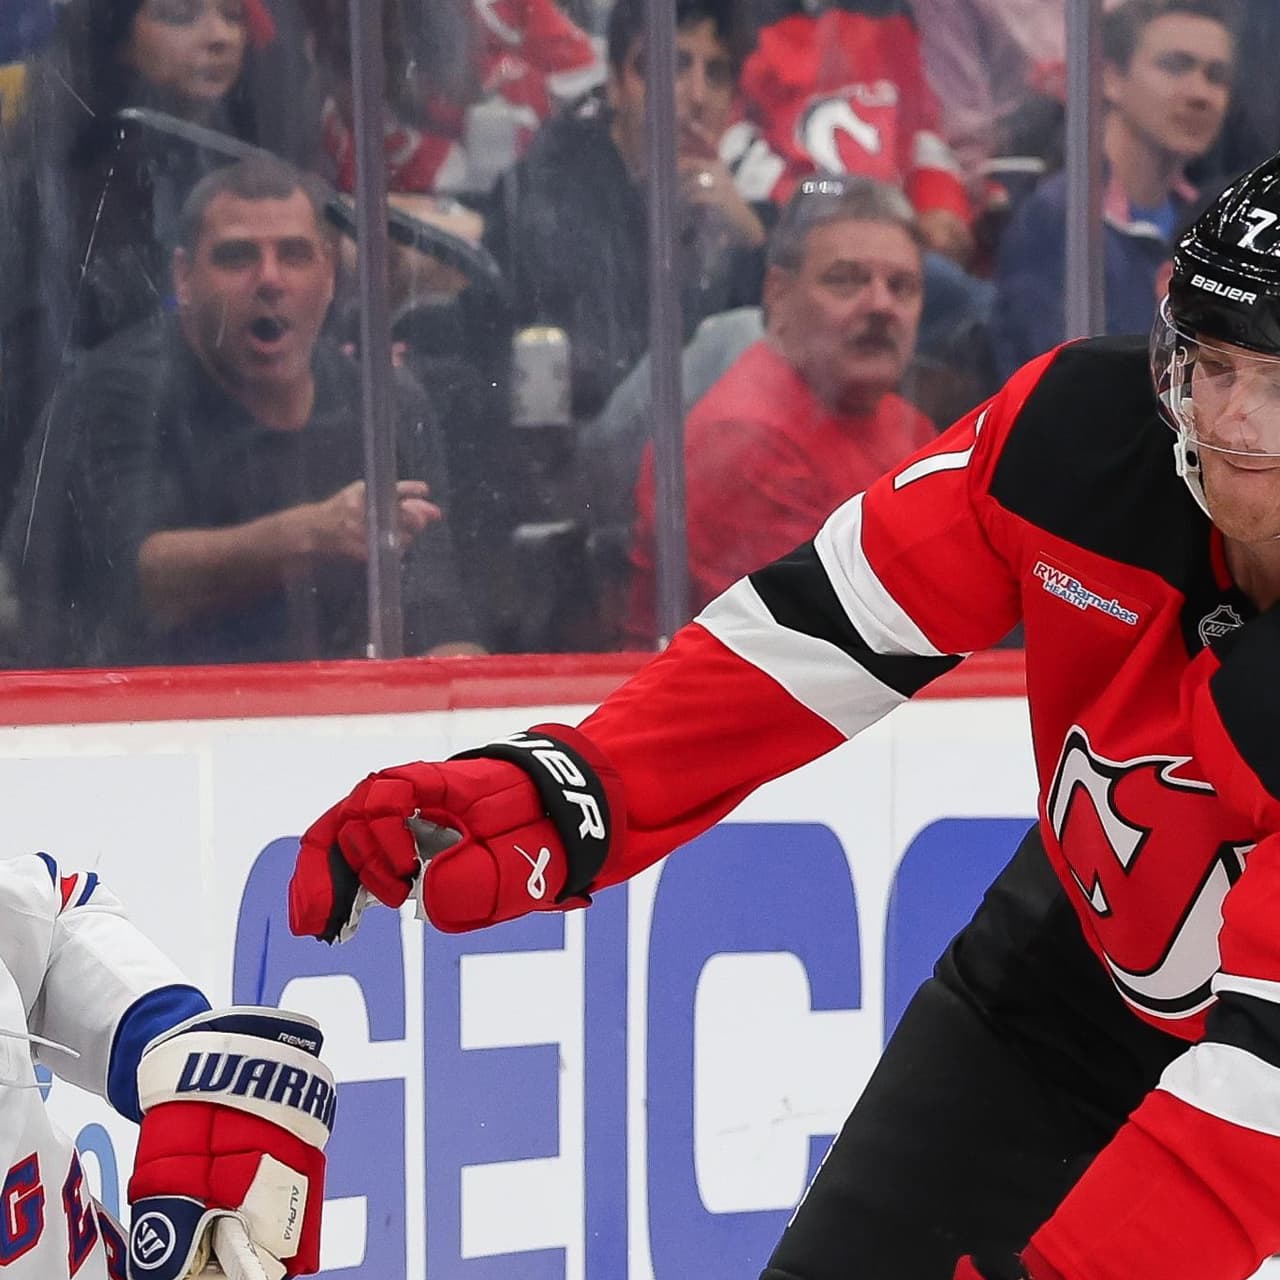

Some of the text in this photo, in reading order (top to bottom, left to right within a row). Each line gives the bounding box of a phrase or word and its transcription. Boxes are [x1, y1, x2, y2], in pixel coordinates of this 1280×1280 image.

[1237, 207, 1278, 248] 7
[1042, 580, 1088, 610] HEALTH
[276, 1031, 317, 1051] REMPE
[176, 1052, 337, 1136] WARR
[282, 1184, 300, 1242] ALPHA
